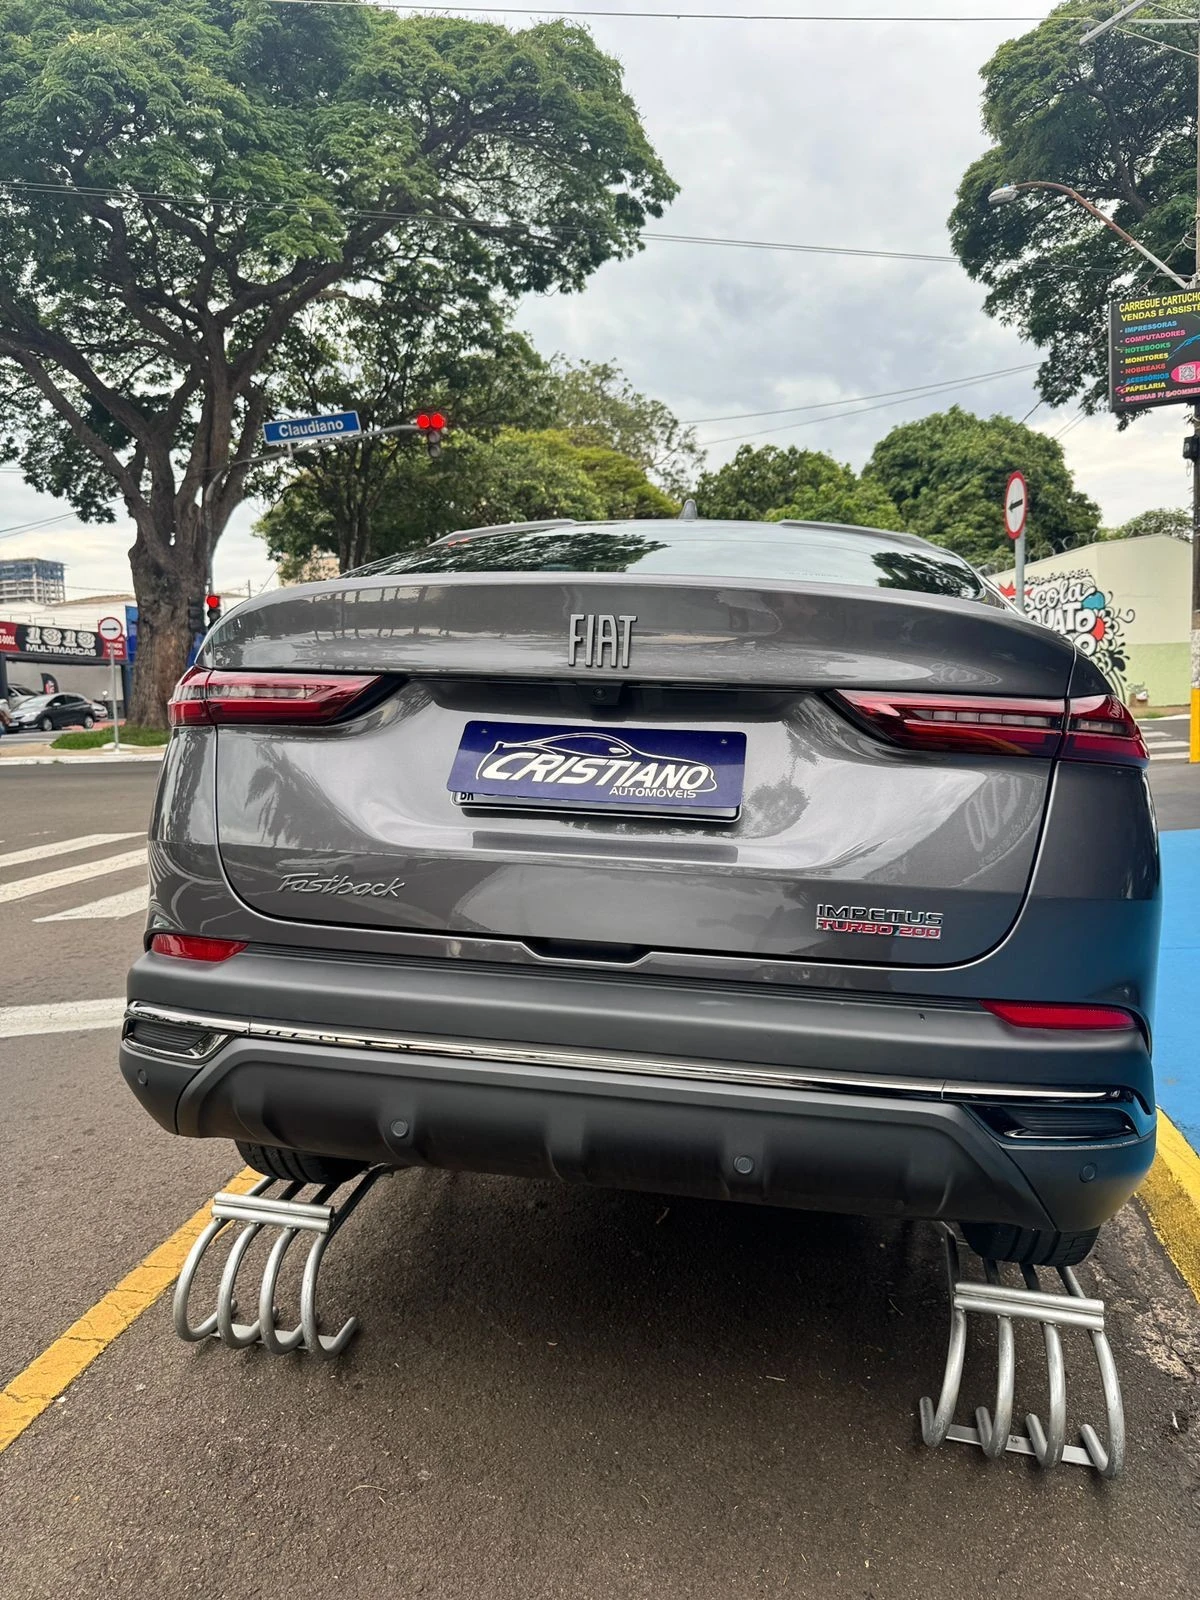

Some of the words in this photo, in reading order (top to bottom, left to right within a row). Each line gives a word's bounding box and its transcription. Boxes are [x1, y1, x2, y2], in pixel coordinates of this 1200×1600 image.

[1119, 298, 1160, 312] CARREGUE
[1121, 311, 1157, 322] VENDAS
[1158, 308, 1165, 317] E
[1125, 321, 1177, 333] IMPRESSORAS
[1125, 330, 1185, 343] COMPUTADORES
[1125, 342, 1171, 353] NOTEBOOKS
[1125, 353, 1168, 363] MONITORES
[1125, 363, 1166, 374] NOBREAKS
[1125, 382, 1166, 393] PAPELARIA
[279, 420, 344, 437] Claudiano
[1014, 578, 1097, 613] scola
[568, 614, 638, 668] FIAT
[26, 643, 97, 656] MULTIMARCAS
[482, 752, 712, 790] CRISTIANO
[609, 784, 697, 799] AUTOMÓVEIS
[276, 872, 405, 897] Fastback
[816, 903, 944, 925] IMPETUS
[820, 918, 894, 936] TURBO
[899, 926, 940, 939] 200
